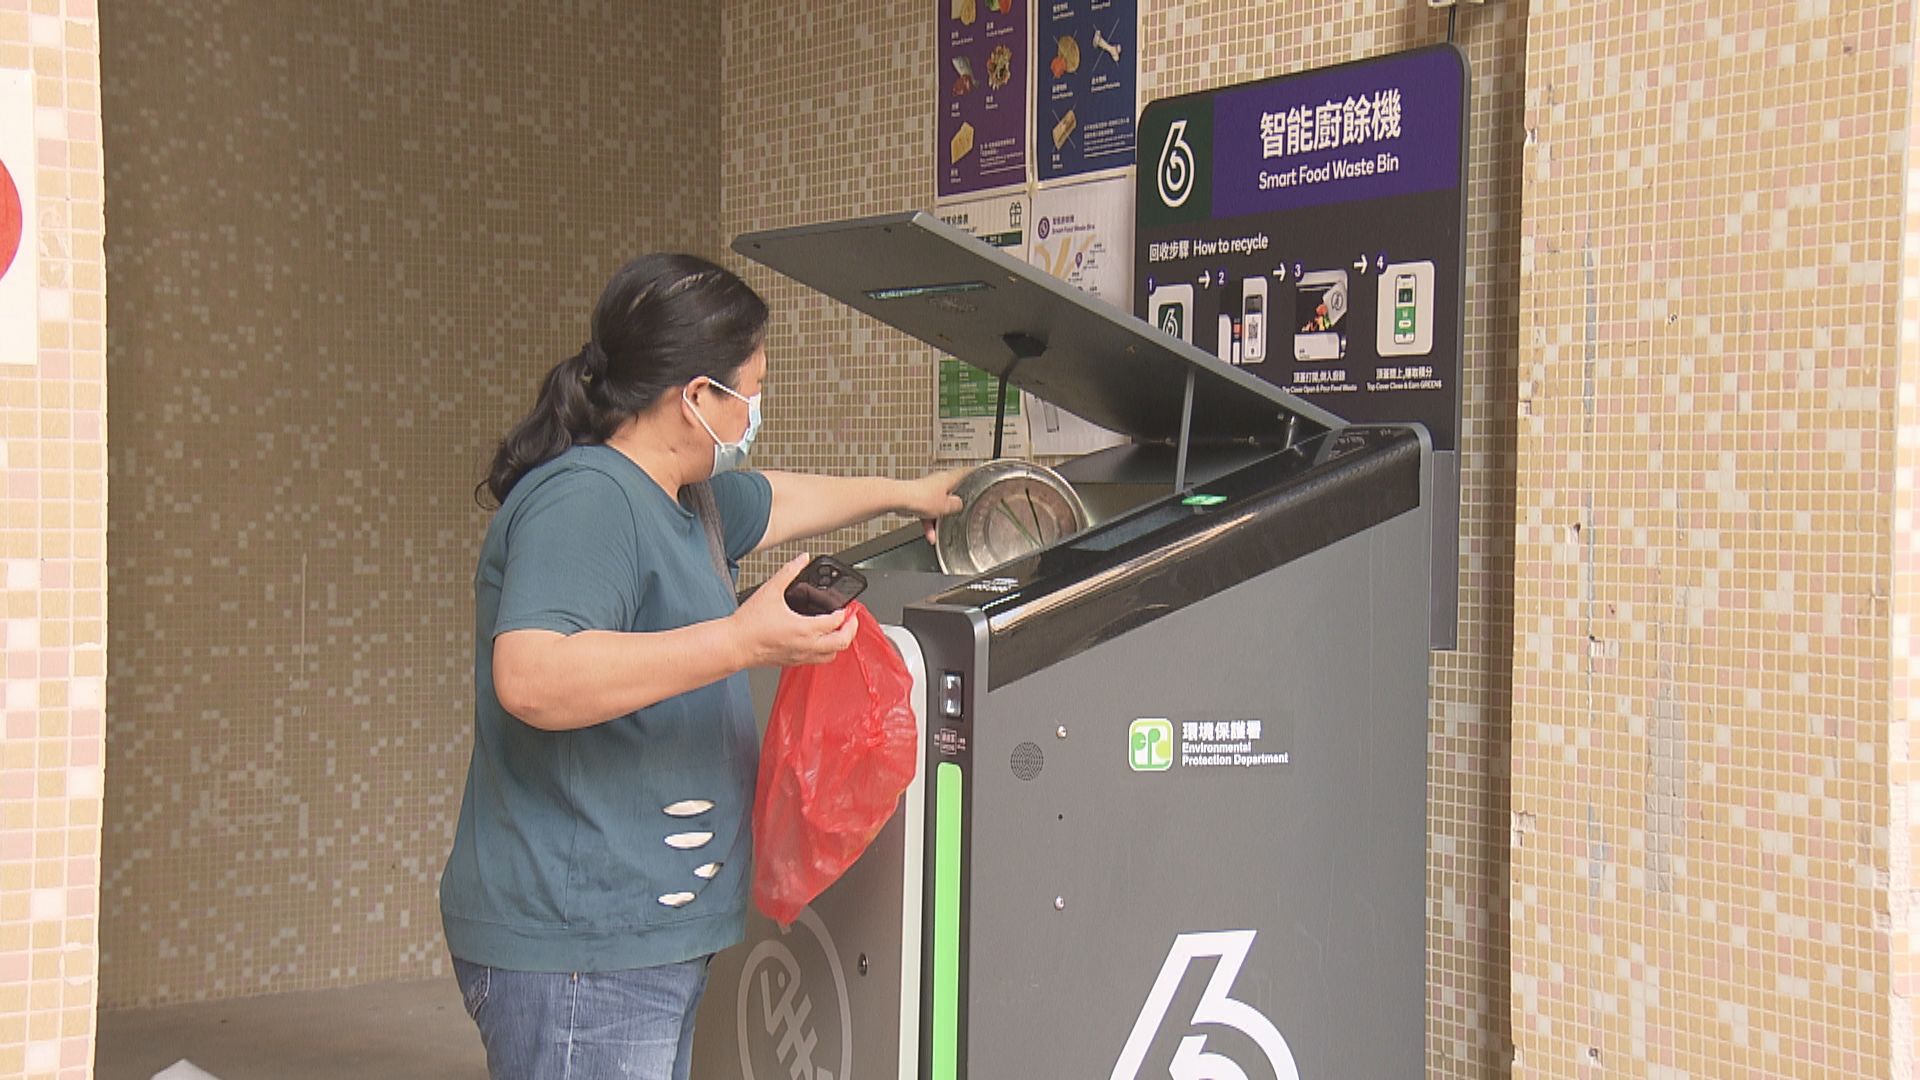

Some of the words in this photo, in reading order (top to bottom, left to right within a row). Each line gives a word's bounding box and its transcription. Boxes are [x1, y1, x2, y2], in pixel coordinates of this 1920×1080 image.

[1260, 88, 1401, 159] 智能廚餘機
[1258, 168, 1297, 190] Smart
[1299, 162, 1330, 184] Food
[1332, 158, 1375, 179] Waste
[1376, 152, 1399, 174] Bin
[1149, 240, 1189, 262] 回收步驟
[1193, 239, 1217, 257] How
[1218, 238, 1231, 254] to
[1231, 231, 1269, 256] recycle
[1294, 263, 1302, 278] 3
[1376, 255, 1384, 270] 4
[1218, 270, 1225, 286] 2
[1366, 382, 1375, 392] Top
[1376, 382, 1389, 391] Cover
[1182, 720, 1261, 741] 環境保護署
[1181, 742, 1252, 754] Environmental
[1181, 753, 1232, 767] Protection
[1233, 751, 1289, 767] Department
